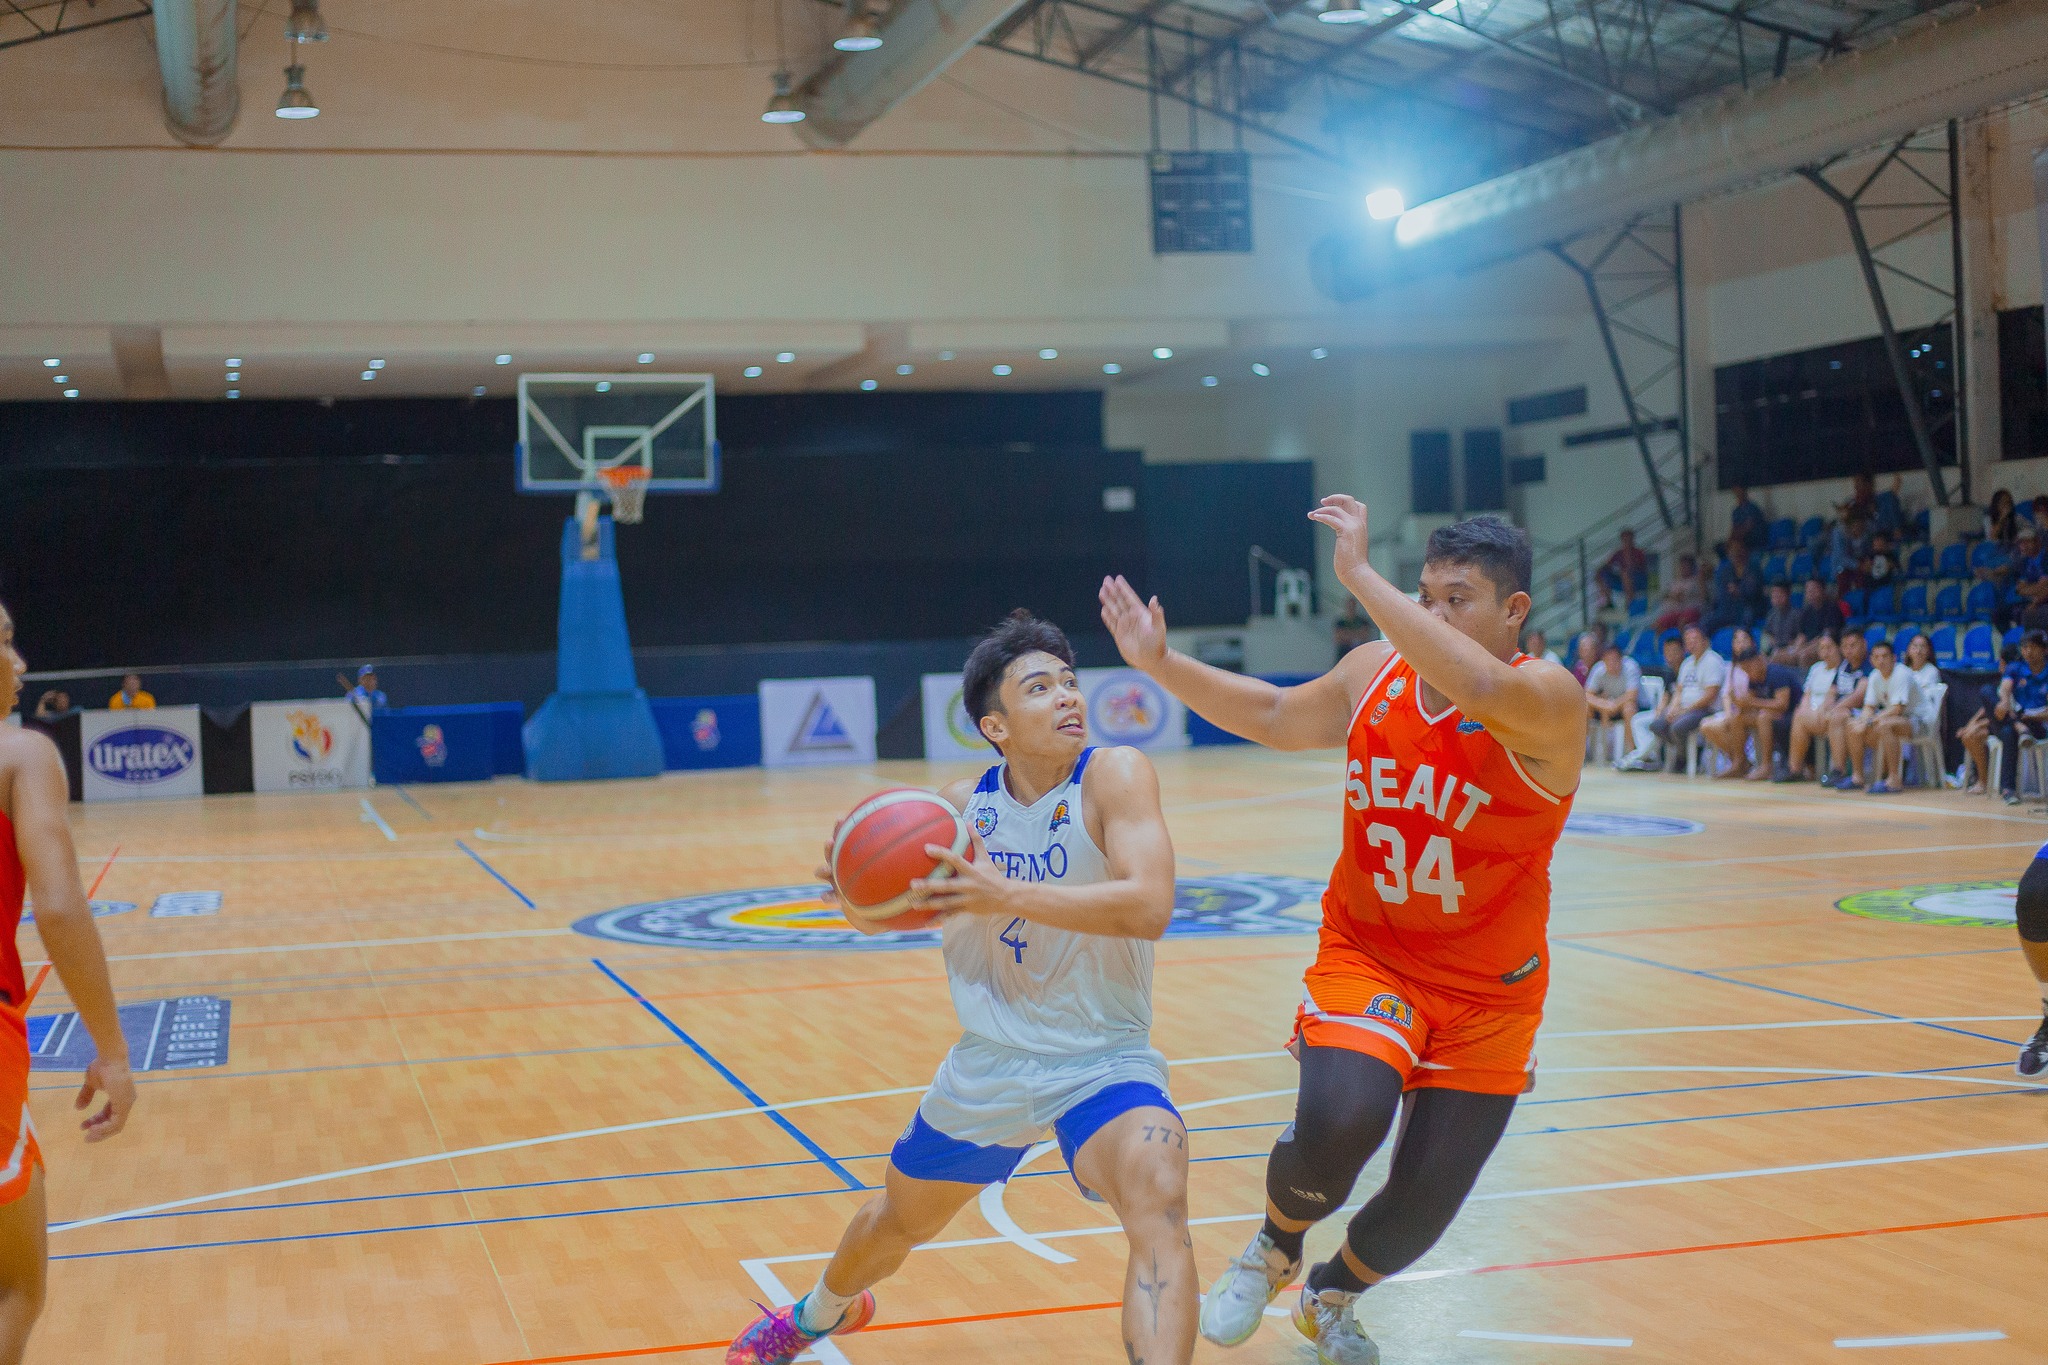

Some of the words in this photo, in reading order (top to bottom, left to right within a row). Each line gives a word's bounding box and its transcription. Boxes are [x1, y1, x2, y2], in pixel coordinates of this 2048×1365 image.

[1346, 757, 1492, 832] SEAIT
[1366, 822, 1466, 914] 34
[999, 916, 1028, 964] 4
[1142, 1125, 1184, 1150] 777
